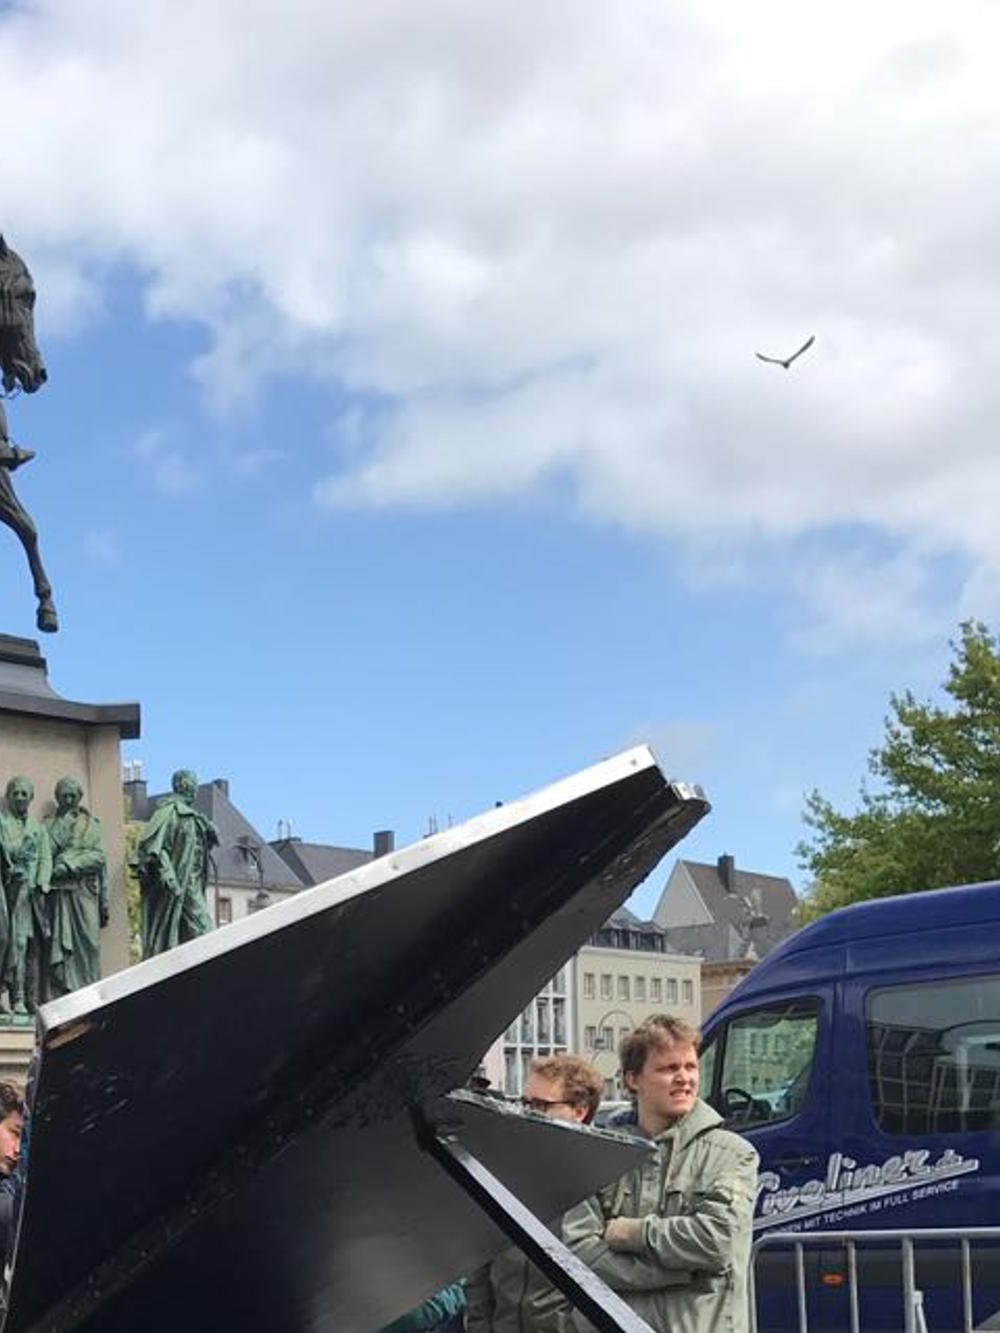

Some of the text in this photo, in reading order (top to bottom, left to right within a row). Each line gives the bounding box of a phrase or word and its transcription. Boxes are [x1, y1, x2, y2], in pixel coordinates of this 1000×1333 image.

[803, 1215, 821, 1230] MIT
[822, 1204, 868, 1224] TECHNIK
[883, 1192, 910, 1209] FULL
[912, 1179, 959, 1201] SERVICE
